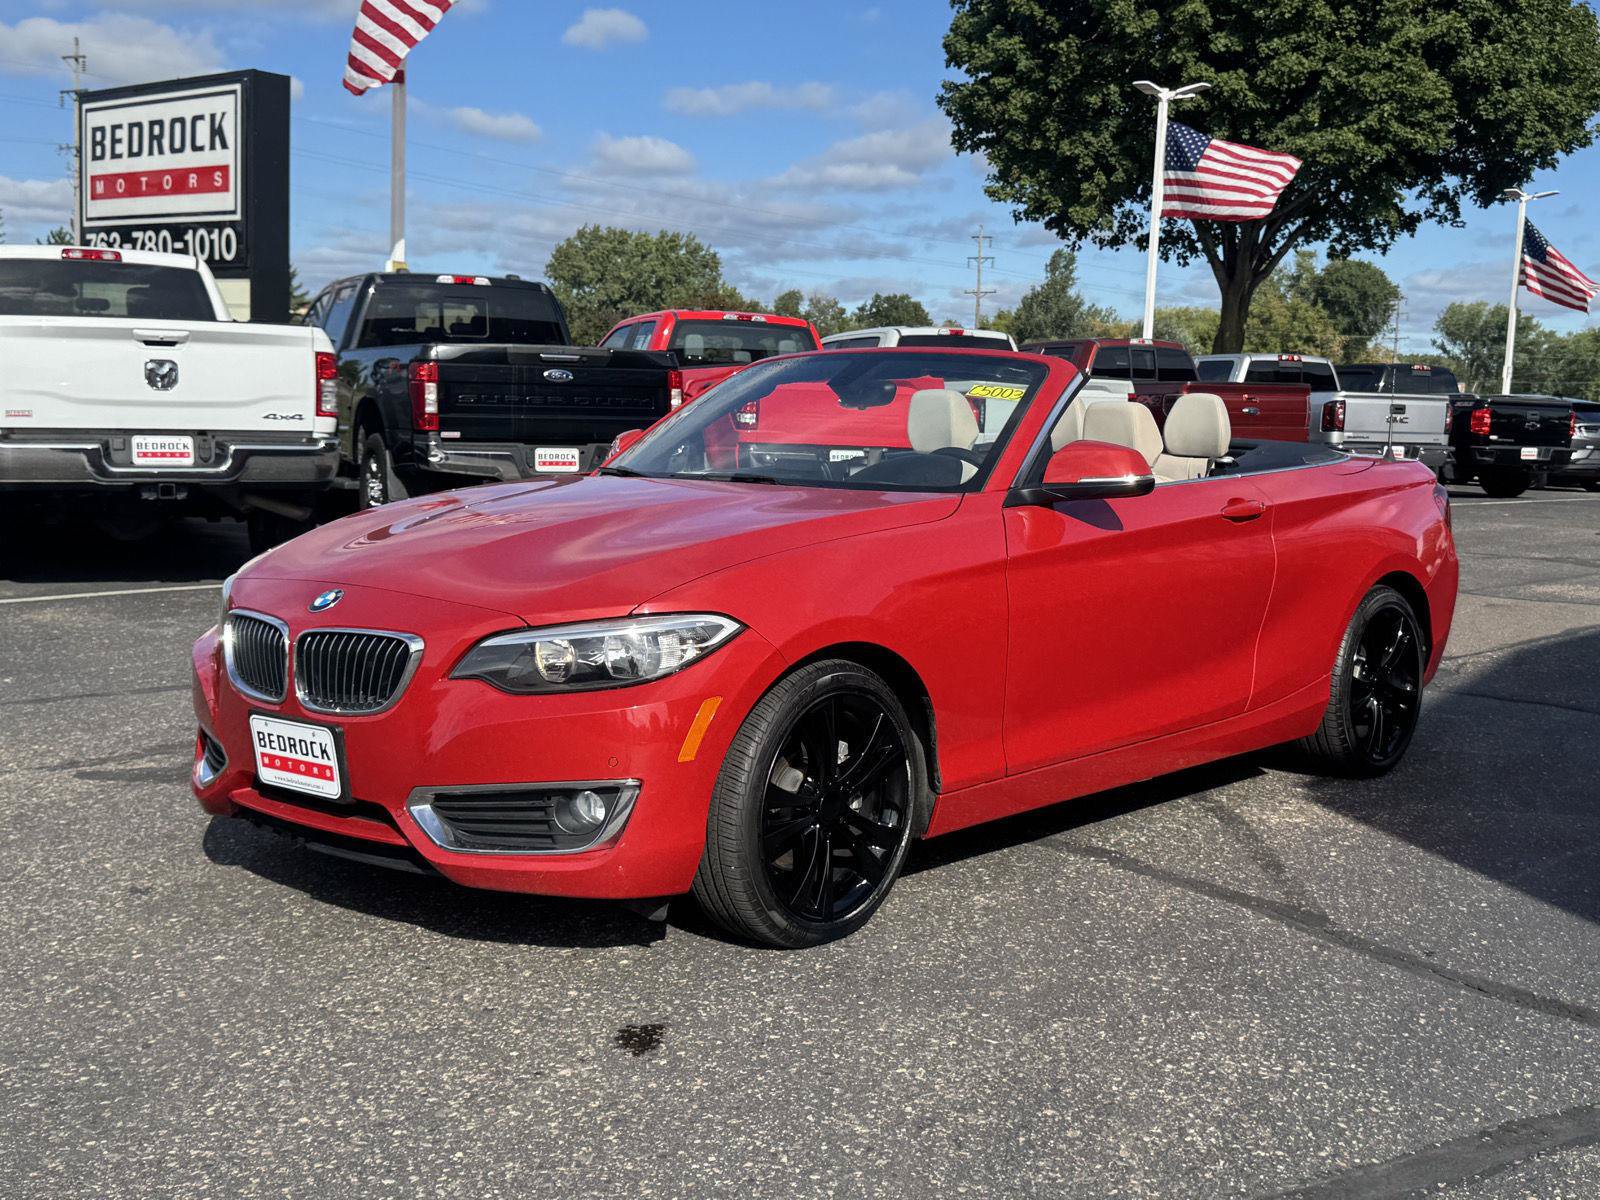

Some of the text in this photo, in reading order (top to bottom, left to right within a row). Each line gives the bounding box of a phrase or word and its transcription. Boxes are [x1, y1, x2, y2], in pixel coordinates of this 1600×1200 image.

[91, 111, 229, 162] BEDROCK
[95, 171, 223, 194] MOTORS
[136, 442, 190, 450] BEDROCK
[256, 730, 332, 761] BEDROCK
[263, 756, 331, 777] MOTORS
